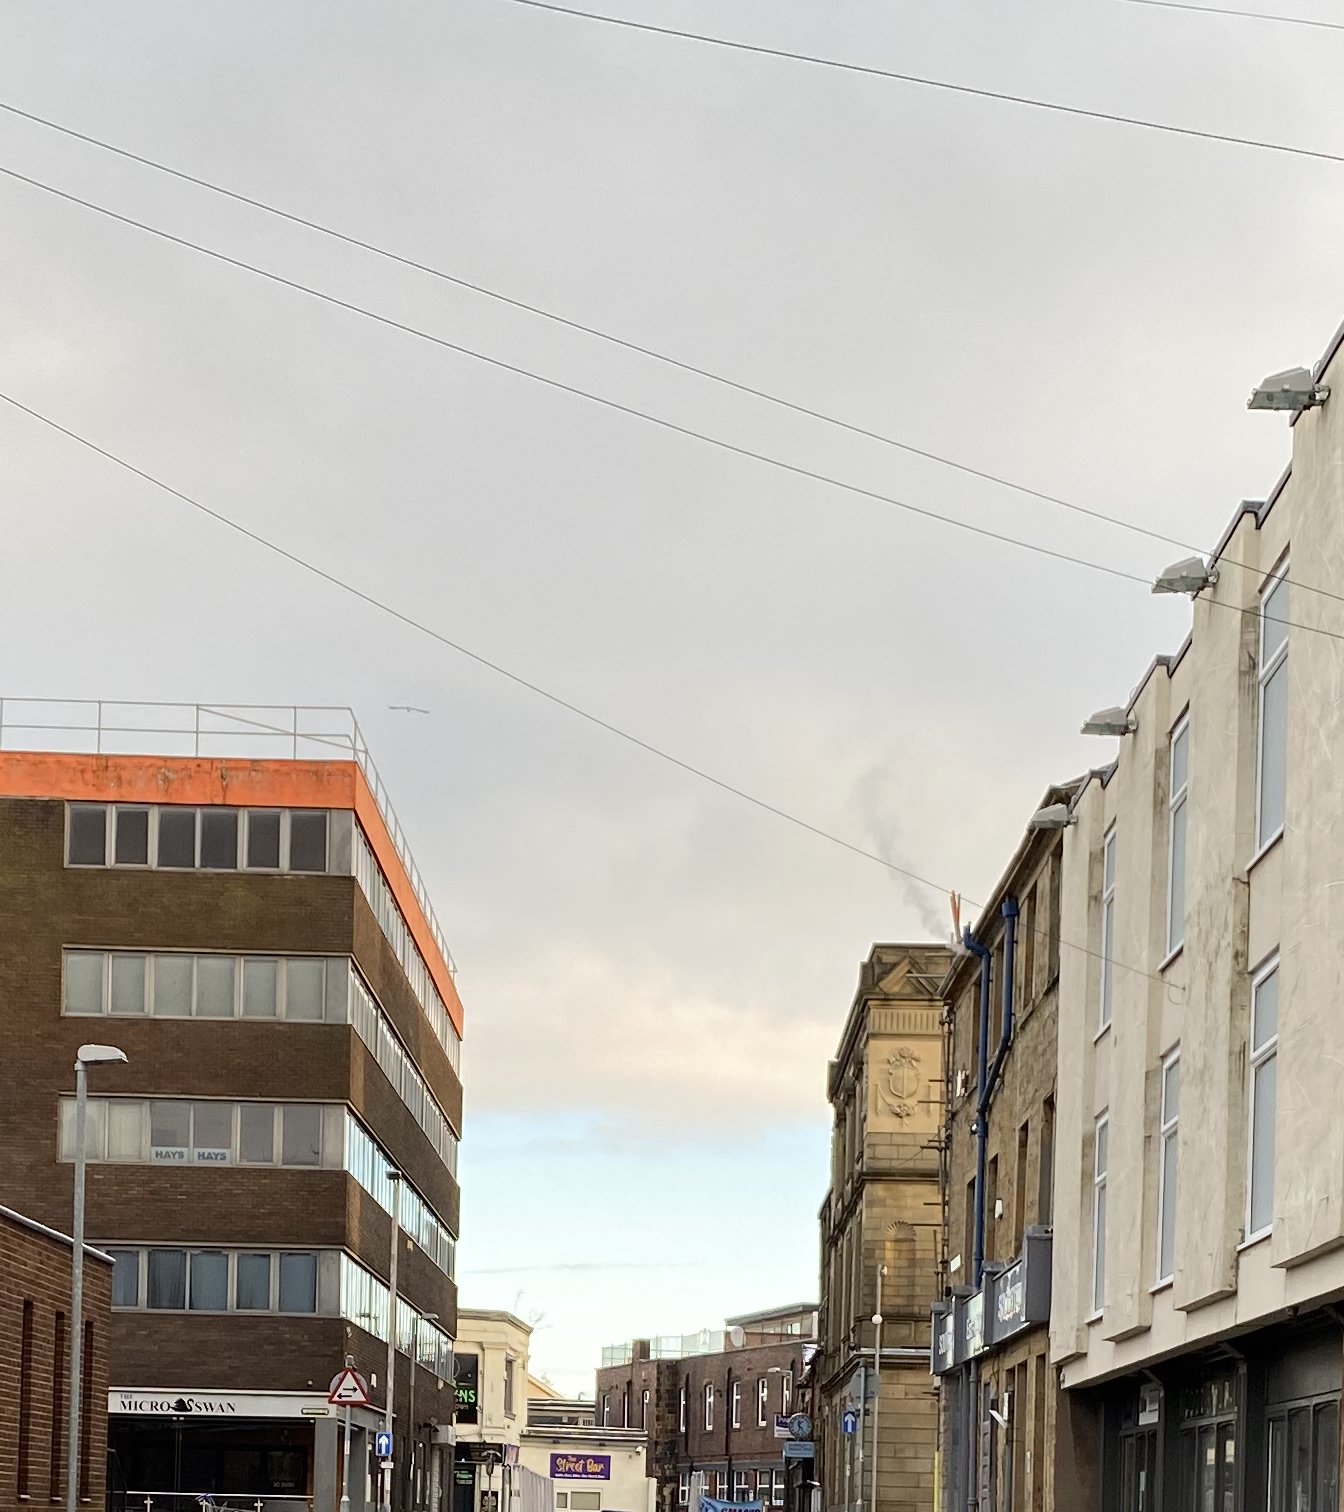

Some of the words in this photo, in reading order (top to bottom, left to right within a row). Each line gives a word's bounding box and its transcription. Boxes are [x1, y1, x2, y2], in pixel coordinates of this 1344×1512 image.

[155, 1150, 184, 1160] HAYS
[197, 1151, 226, 1161] HAYS
[120, 1400, 171, 1412] MICRO
[195, 1401, 236, 1413] SWAN
[556, 1457, 585, 1473] Street
[587, 1458, 605, 1473] Bar
